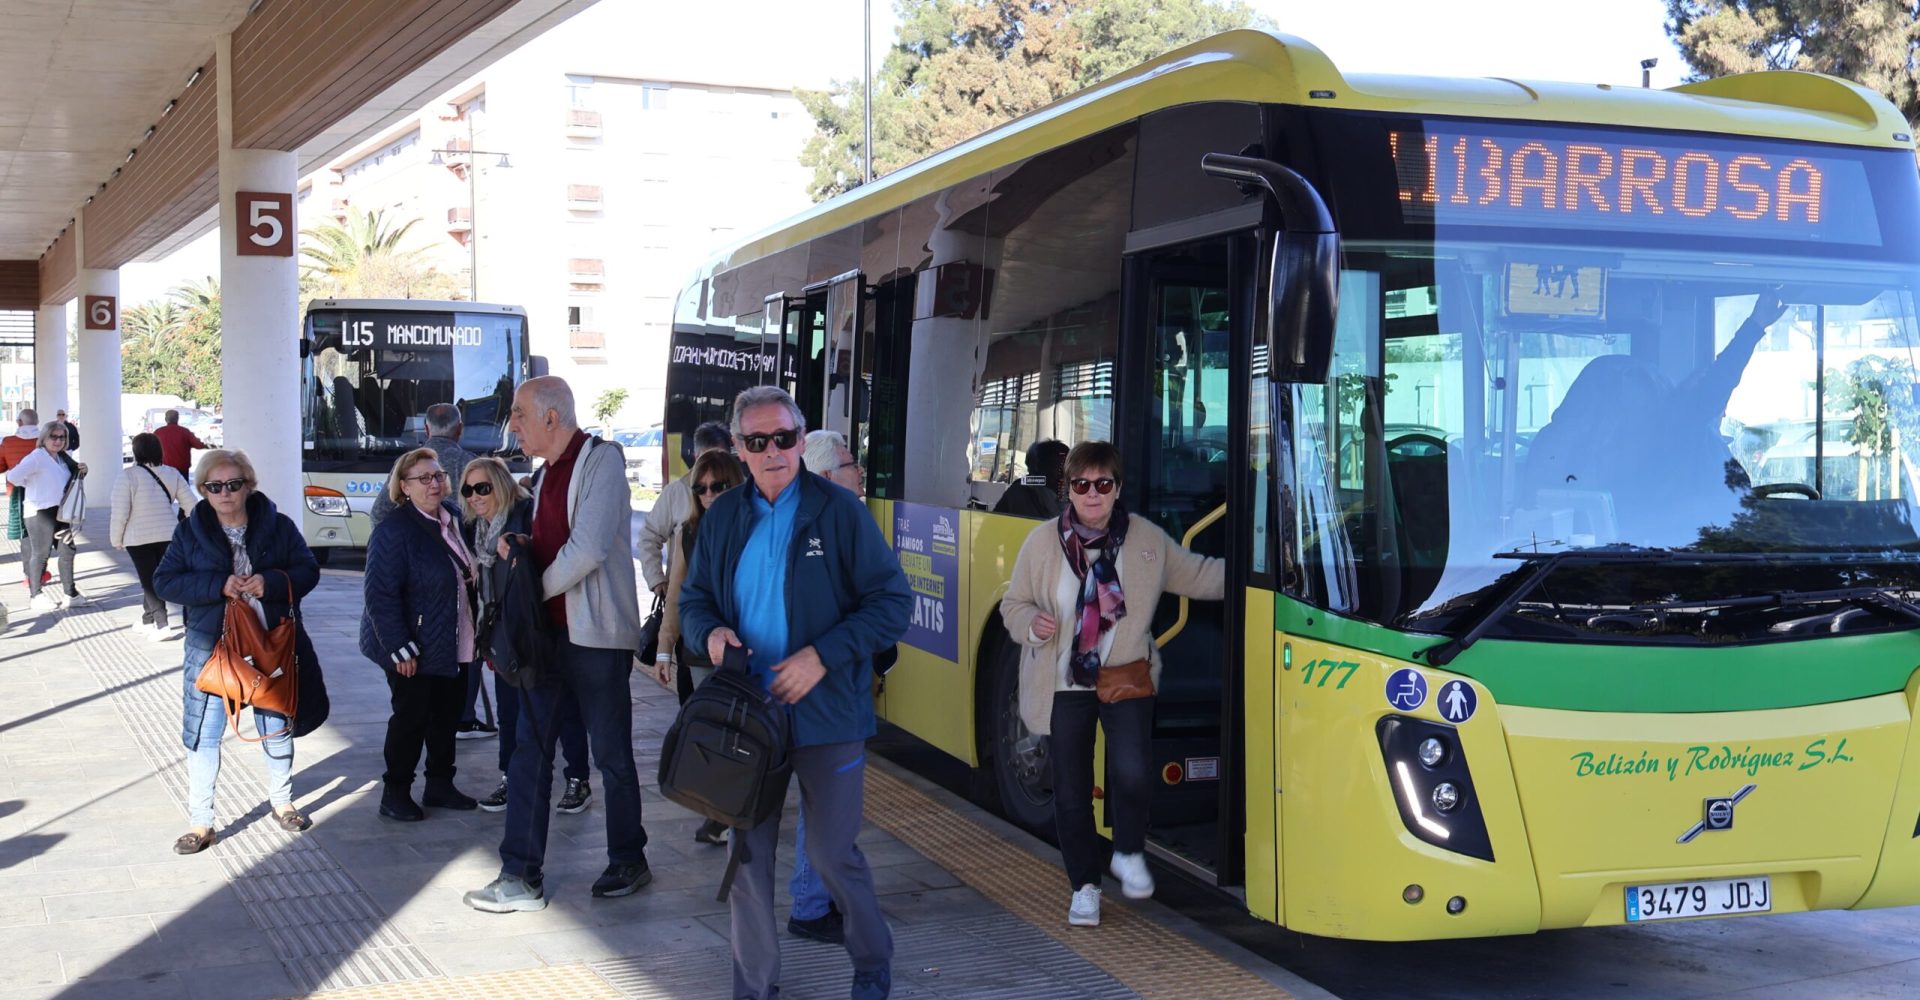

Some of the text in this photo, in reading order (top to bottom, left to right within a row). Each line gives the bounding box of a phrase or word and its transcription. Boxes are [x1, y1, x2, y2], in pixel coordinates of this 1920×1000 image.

[249, 200, 283, 247] 5
[91, 300, 112, 326] 6
[341, 320, 483, 347] L15 MANCOMUNADO
[901, 536, 924, 552] AMIGOS
[917, 576, 944, 595] INTERNET
[910, 595, 944, 634] ATIS
[1301, 658, 1361, 690] 177
[1570, 738, 1855, 781] Belizón y Rodríguez S.L.
[1631, 880, 1768, 917] E 3479 JDJ
